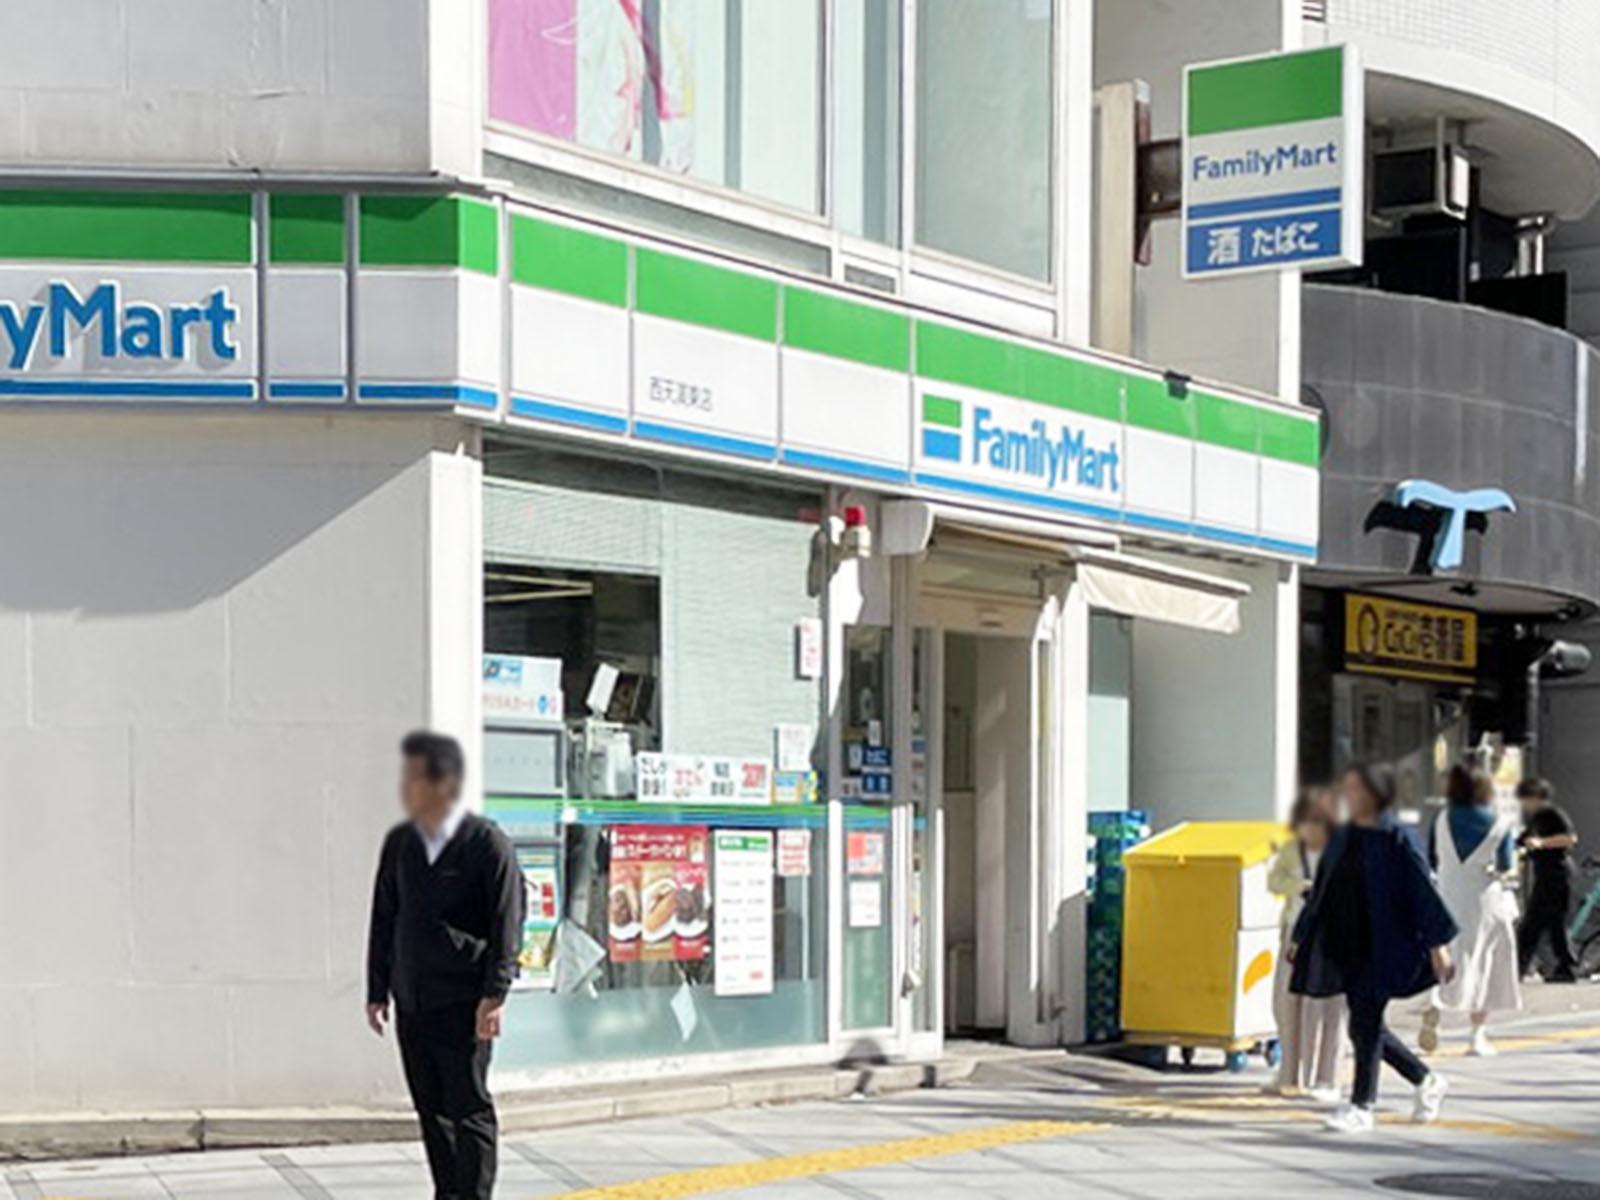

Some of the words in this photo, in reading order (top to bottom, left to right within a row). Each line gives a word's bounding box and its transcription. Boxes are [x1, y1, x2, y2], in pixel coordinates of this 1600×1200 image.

[1192, 142, 1337, 181] FamilyMart
[1207, 226, 1241, 265] 酒
[1252, 221, 1319, 257] たばこ
[0, 281, 237, 370] yMart
[972, 405, 1119, 493] FamilyMart
